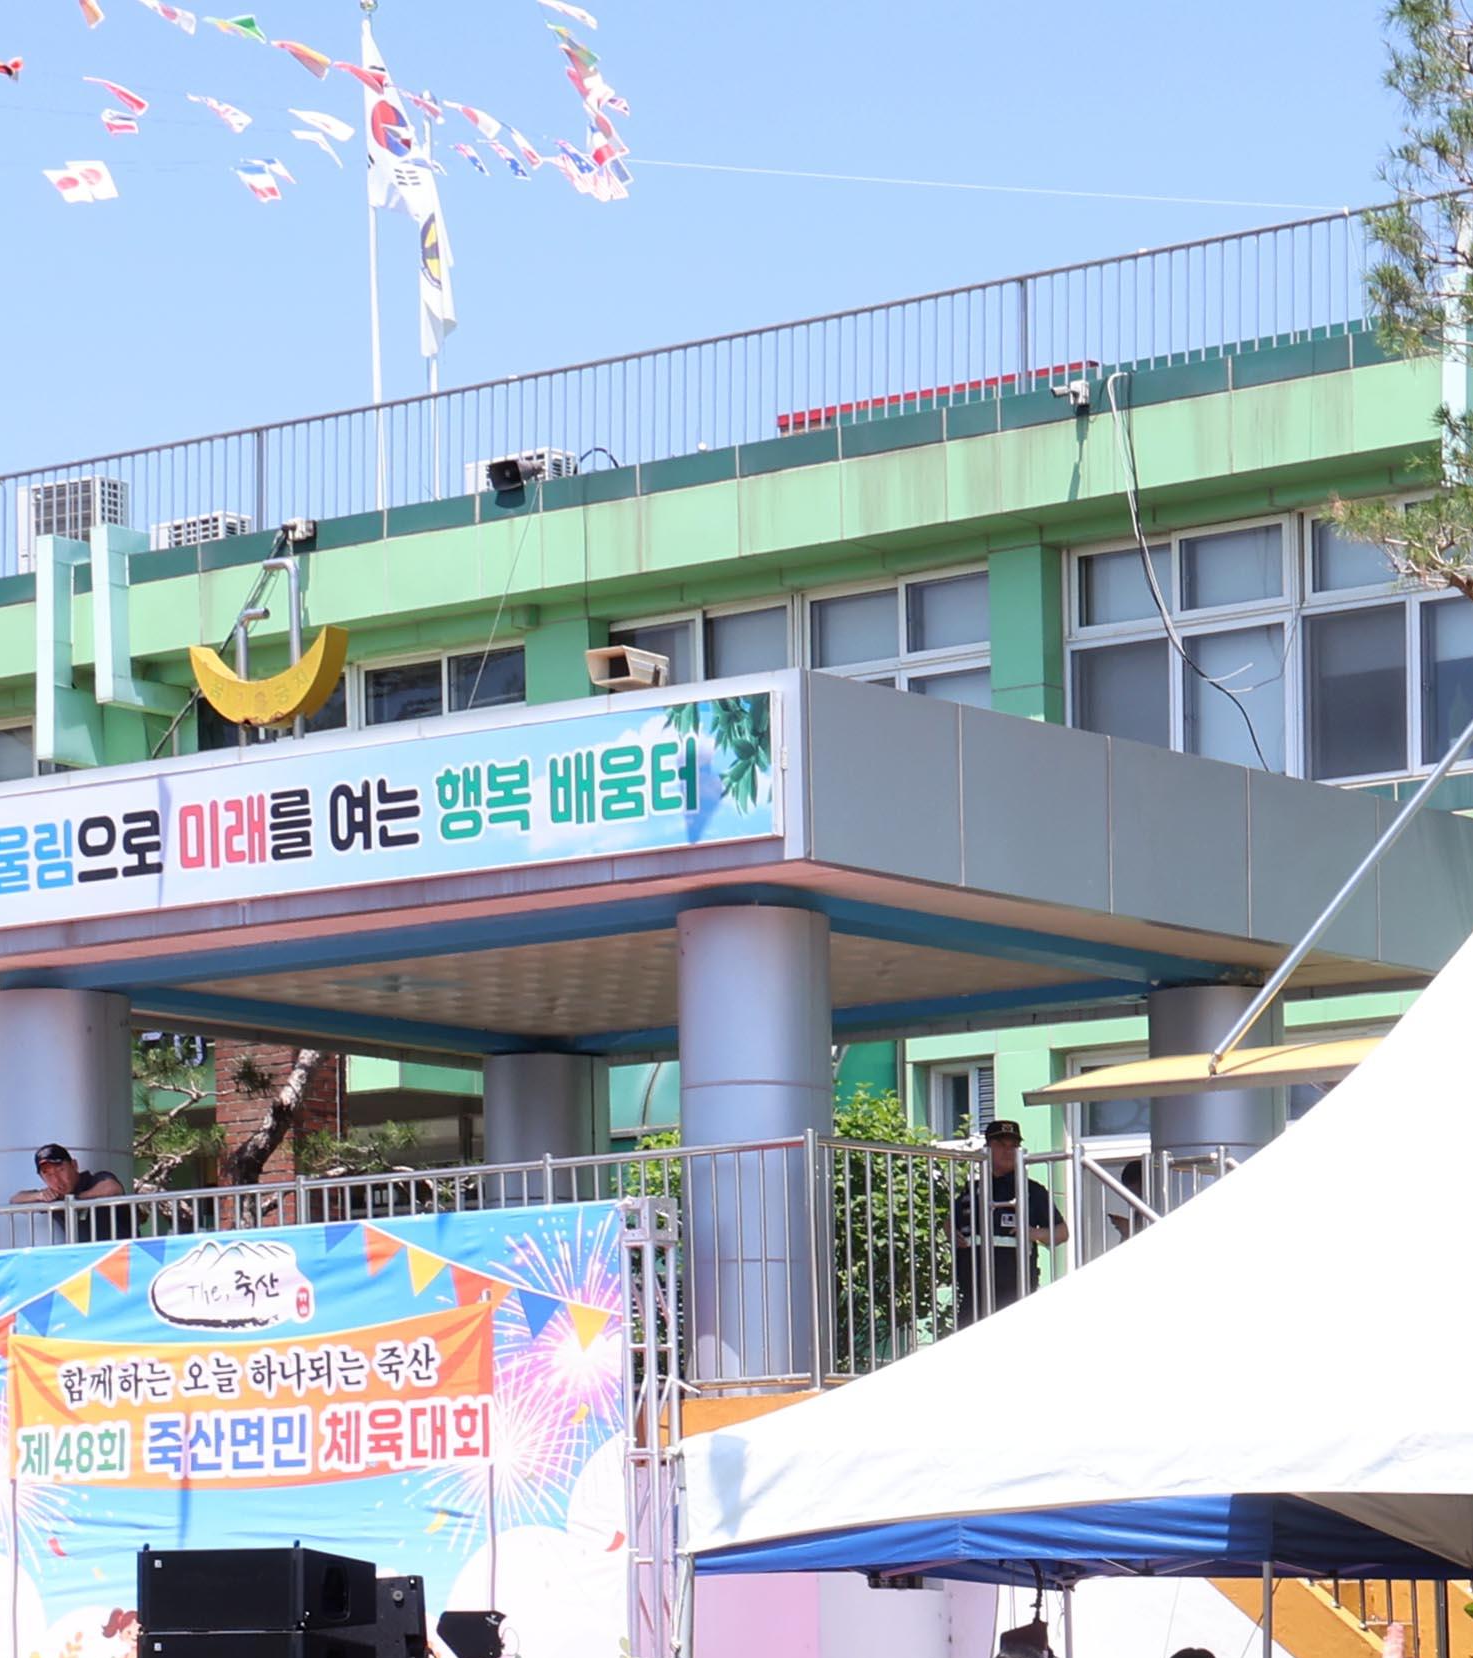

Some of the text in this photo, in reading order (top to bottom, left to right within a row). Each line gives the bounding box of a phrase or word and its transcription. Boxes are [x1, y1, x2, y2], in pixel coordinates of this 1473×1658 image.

[177, 786, 315, 871] 미래를
[328, 776, 423, 853] 여는
[434, 757, 531, 842] 행복
[549, 735, 700, 826] 배움터
[234, 1270, 280, 1308] 죽산
[61, 1340, 437, 1405] 함께하는 오늘 하나되는 죽산
[20, 1404, 493, 1477] 제48회 죽산면민 체육대회
